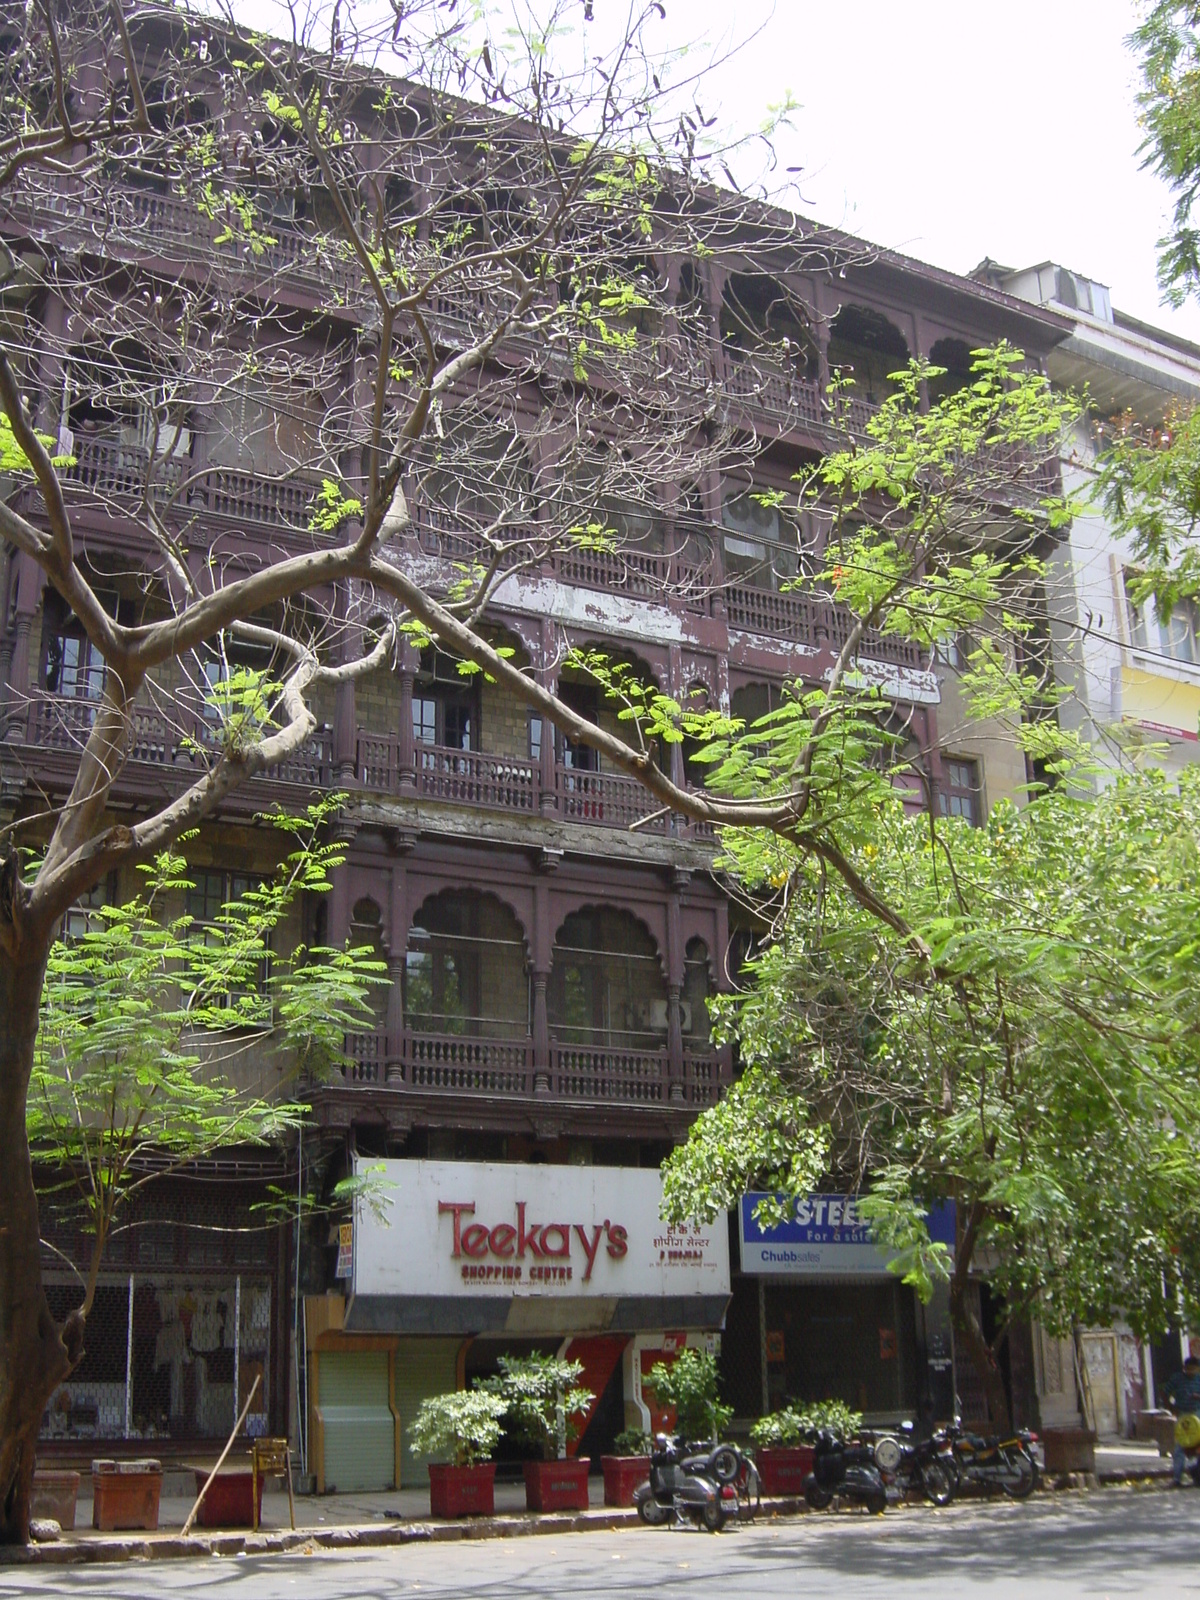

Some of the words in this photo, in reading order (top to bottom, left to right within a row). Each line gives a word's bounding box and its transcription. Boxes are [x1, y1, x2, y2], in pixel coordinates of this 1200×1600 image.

[438, 1200, 628, 1281] Teekay's
[807, 1229, 828, 1242] For
[833, 1231, 842, 1242] a
[461, 1264, 522, 1280] SHOPPING
[528, 1266, 573, 1280] CENTRE
